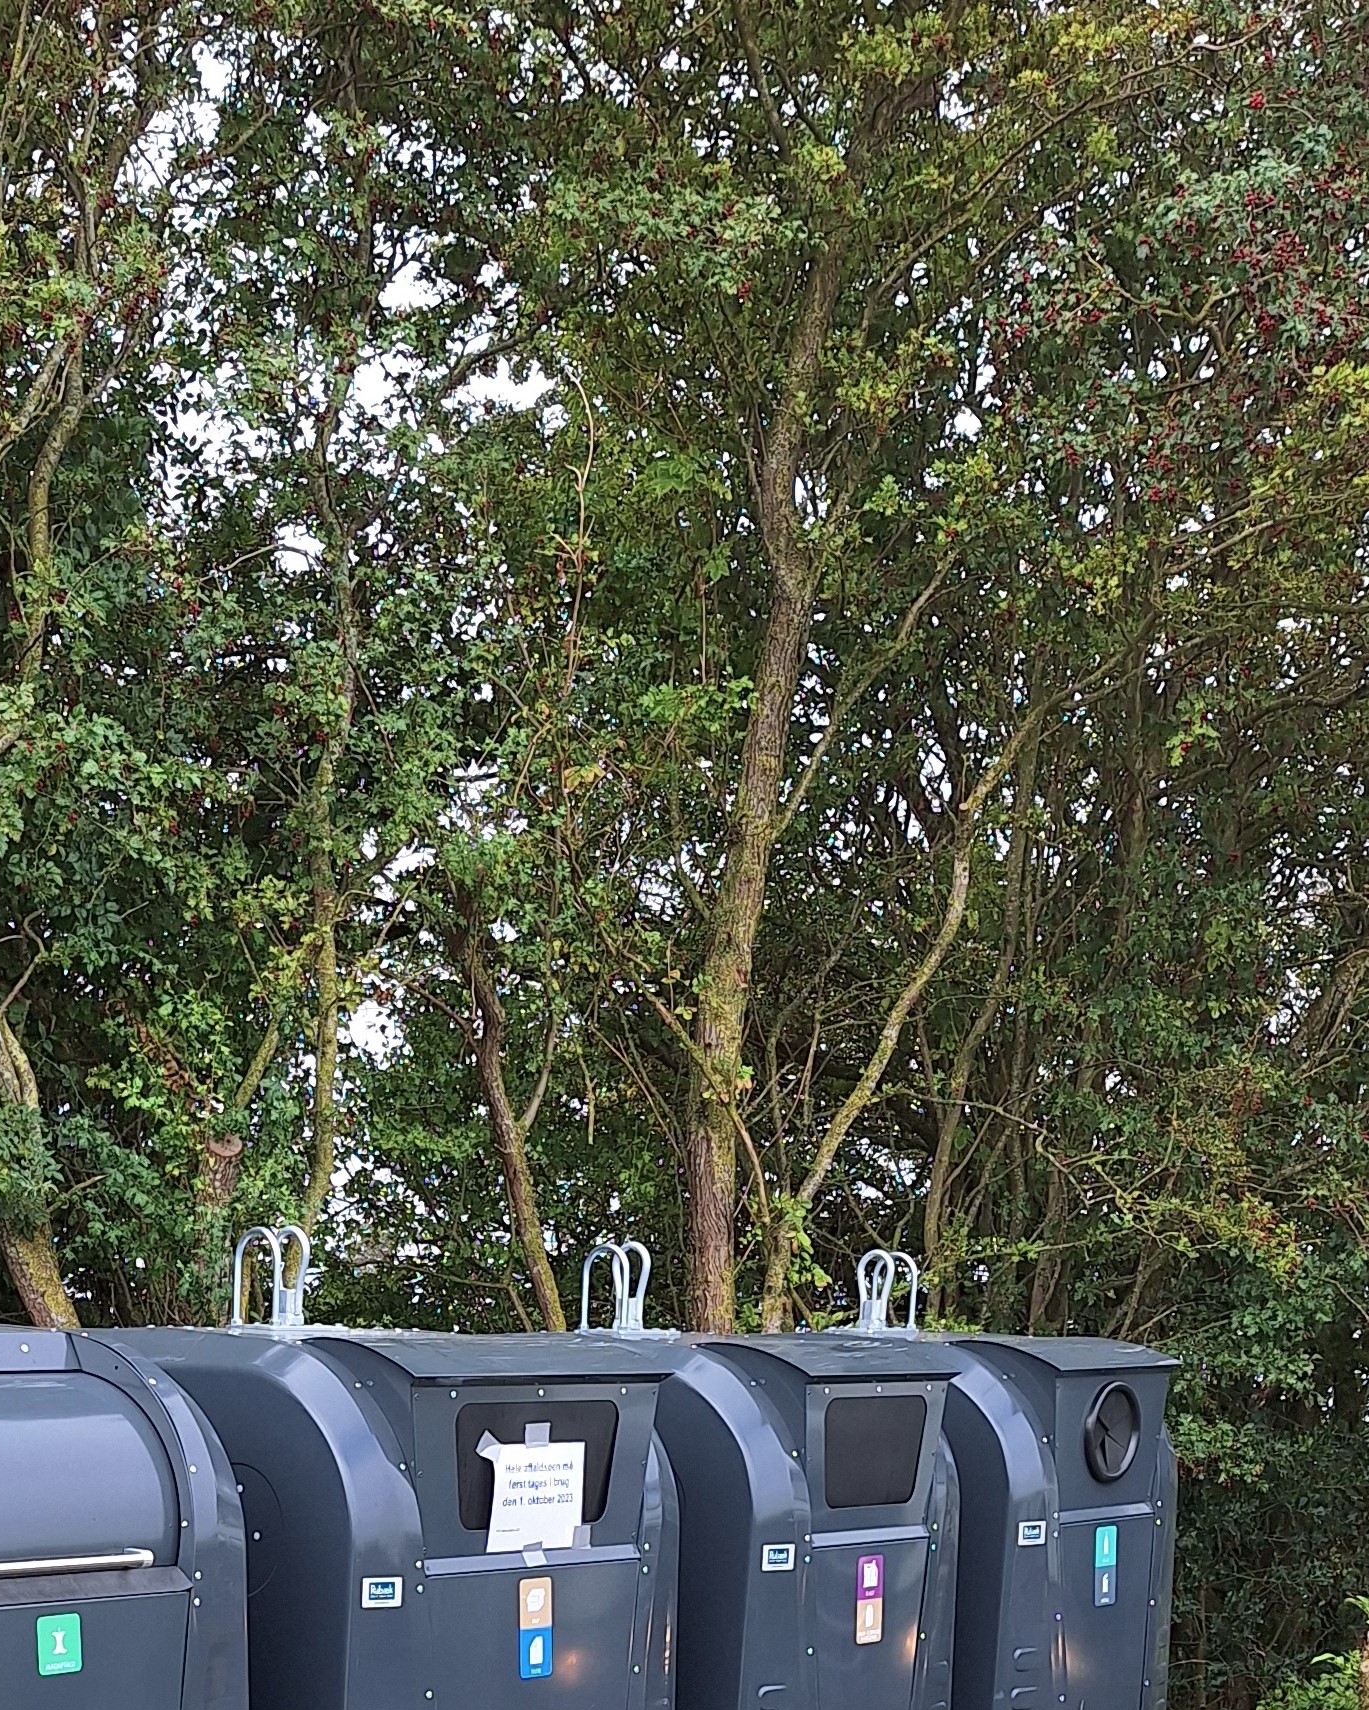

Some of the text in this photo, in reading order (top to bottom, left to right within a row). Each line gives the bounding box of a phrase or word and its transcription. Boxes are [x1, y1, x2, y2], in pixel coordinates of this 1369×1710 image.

[554, 1477, 569, 1489] brug
[502, 1496, 517, 1507] den
[528, 1495, 555, 1505] oktober
